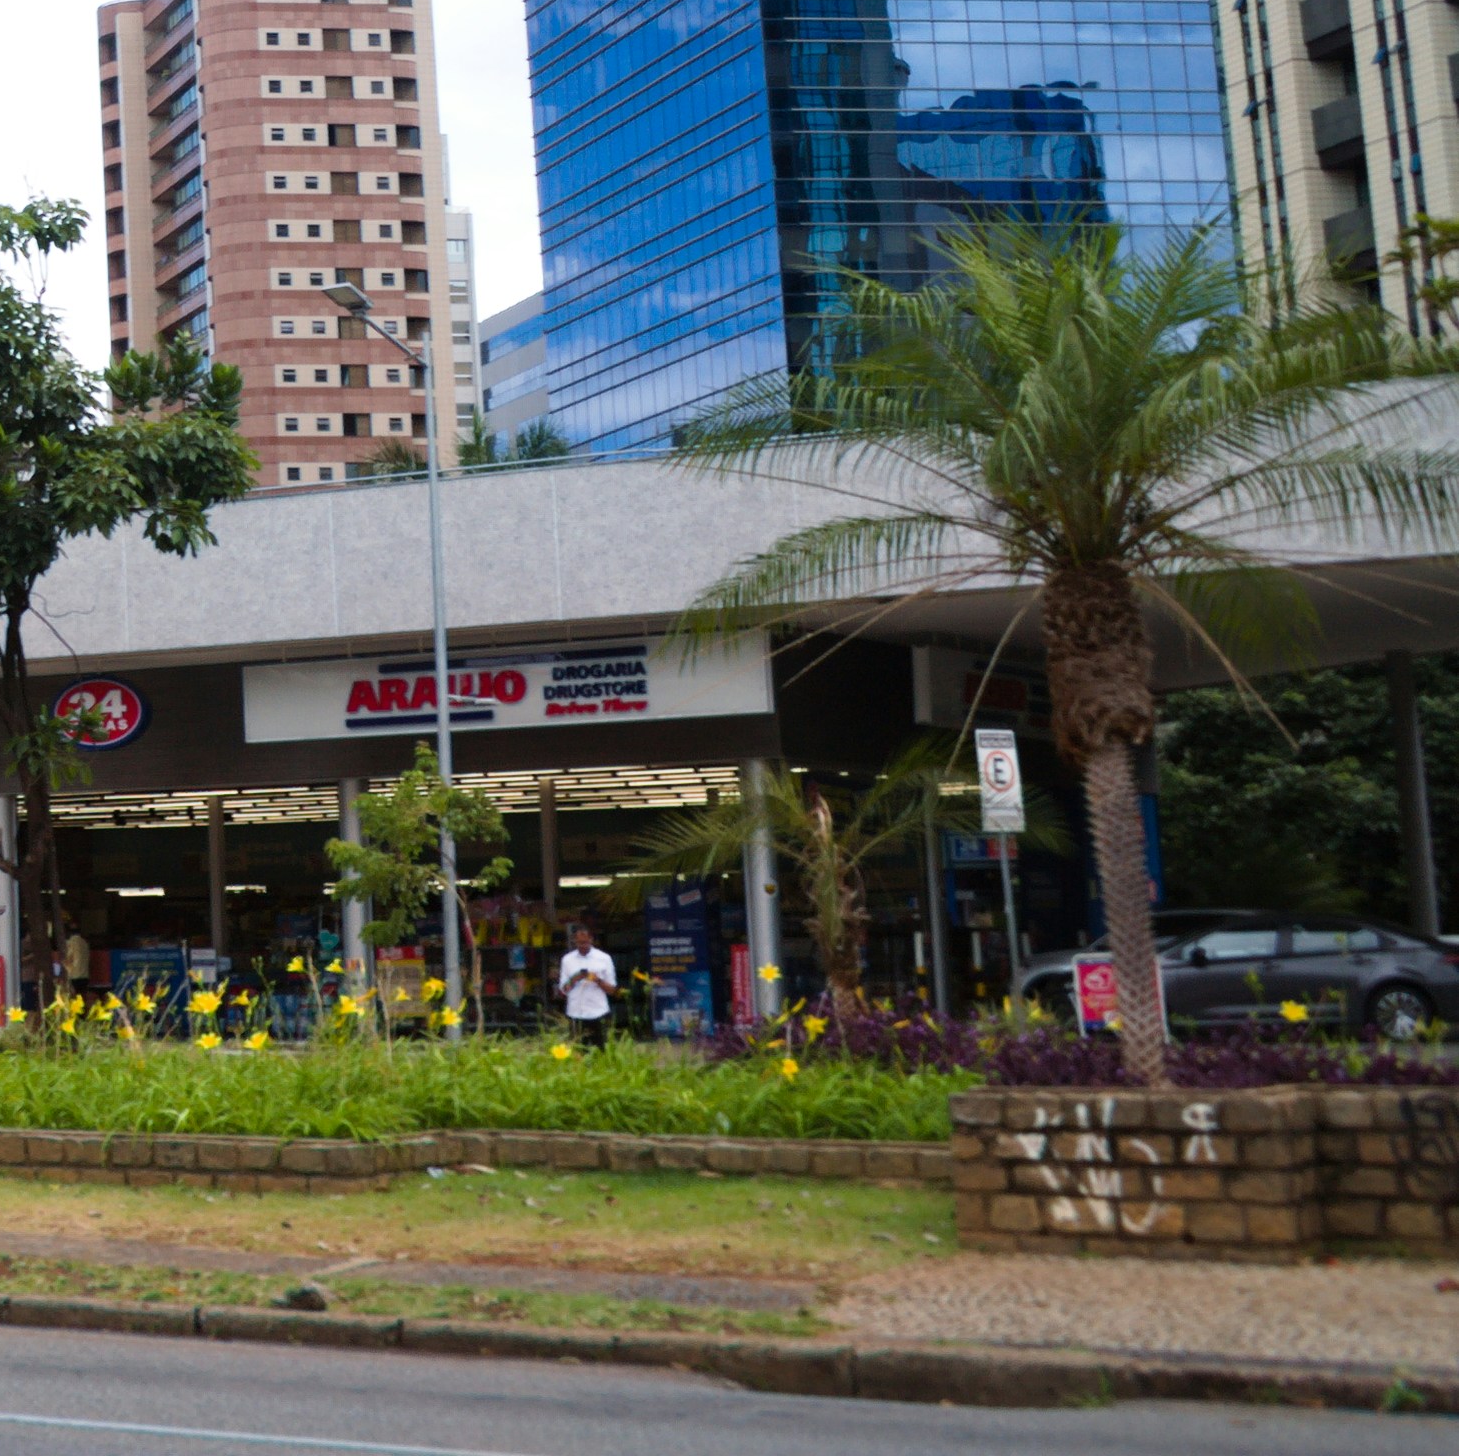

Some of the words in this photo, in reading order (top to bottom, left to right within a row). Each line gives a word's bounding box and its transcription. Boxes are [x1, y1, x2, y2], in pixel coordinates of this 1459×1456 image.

[551, 661, 646, 681] DROGARIA
[346, 670, 527, 713] ARAUJO
[543, 679, 647, 700] DRUGSTORE
[68, 689, 127, 721] 24
[993, 757, 1007, 784] E
